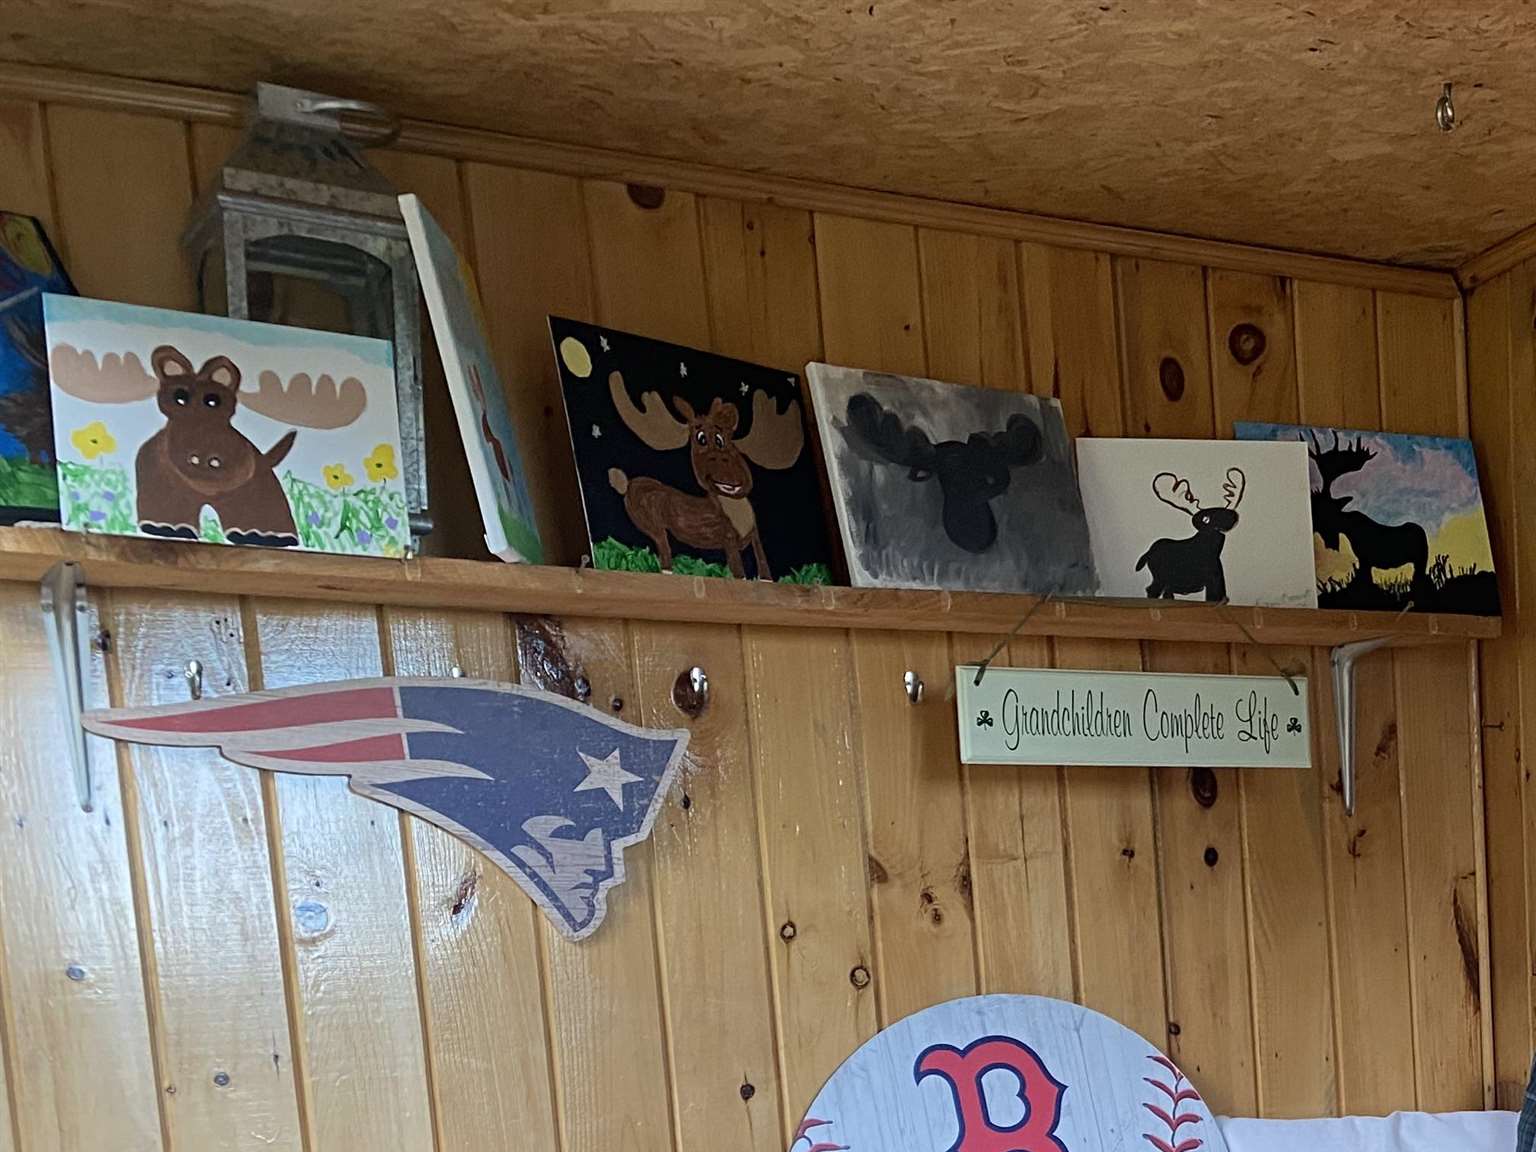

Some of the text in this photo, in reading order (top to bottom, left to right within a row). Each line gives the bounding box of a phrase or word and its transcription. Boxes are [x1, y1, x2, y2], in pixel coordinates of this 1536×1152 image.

[1001, 687, 1280, 754] Grandchildren Complete Life
